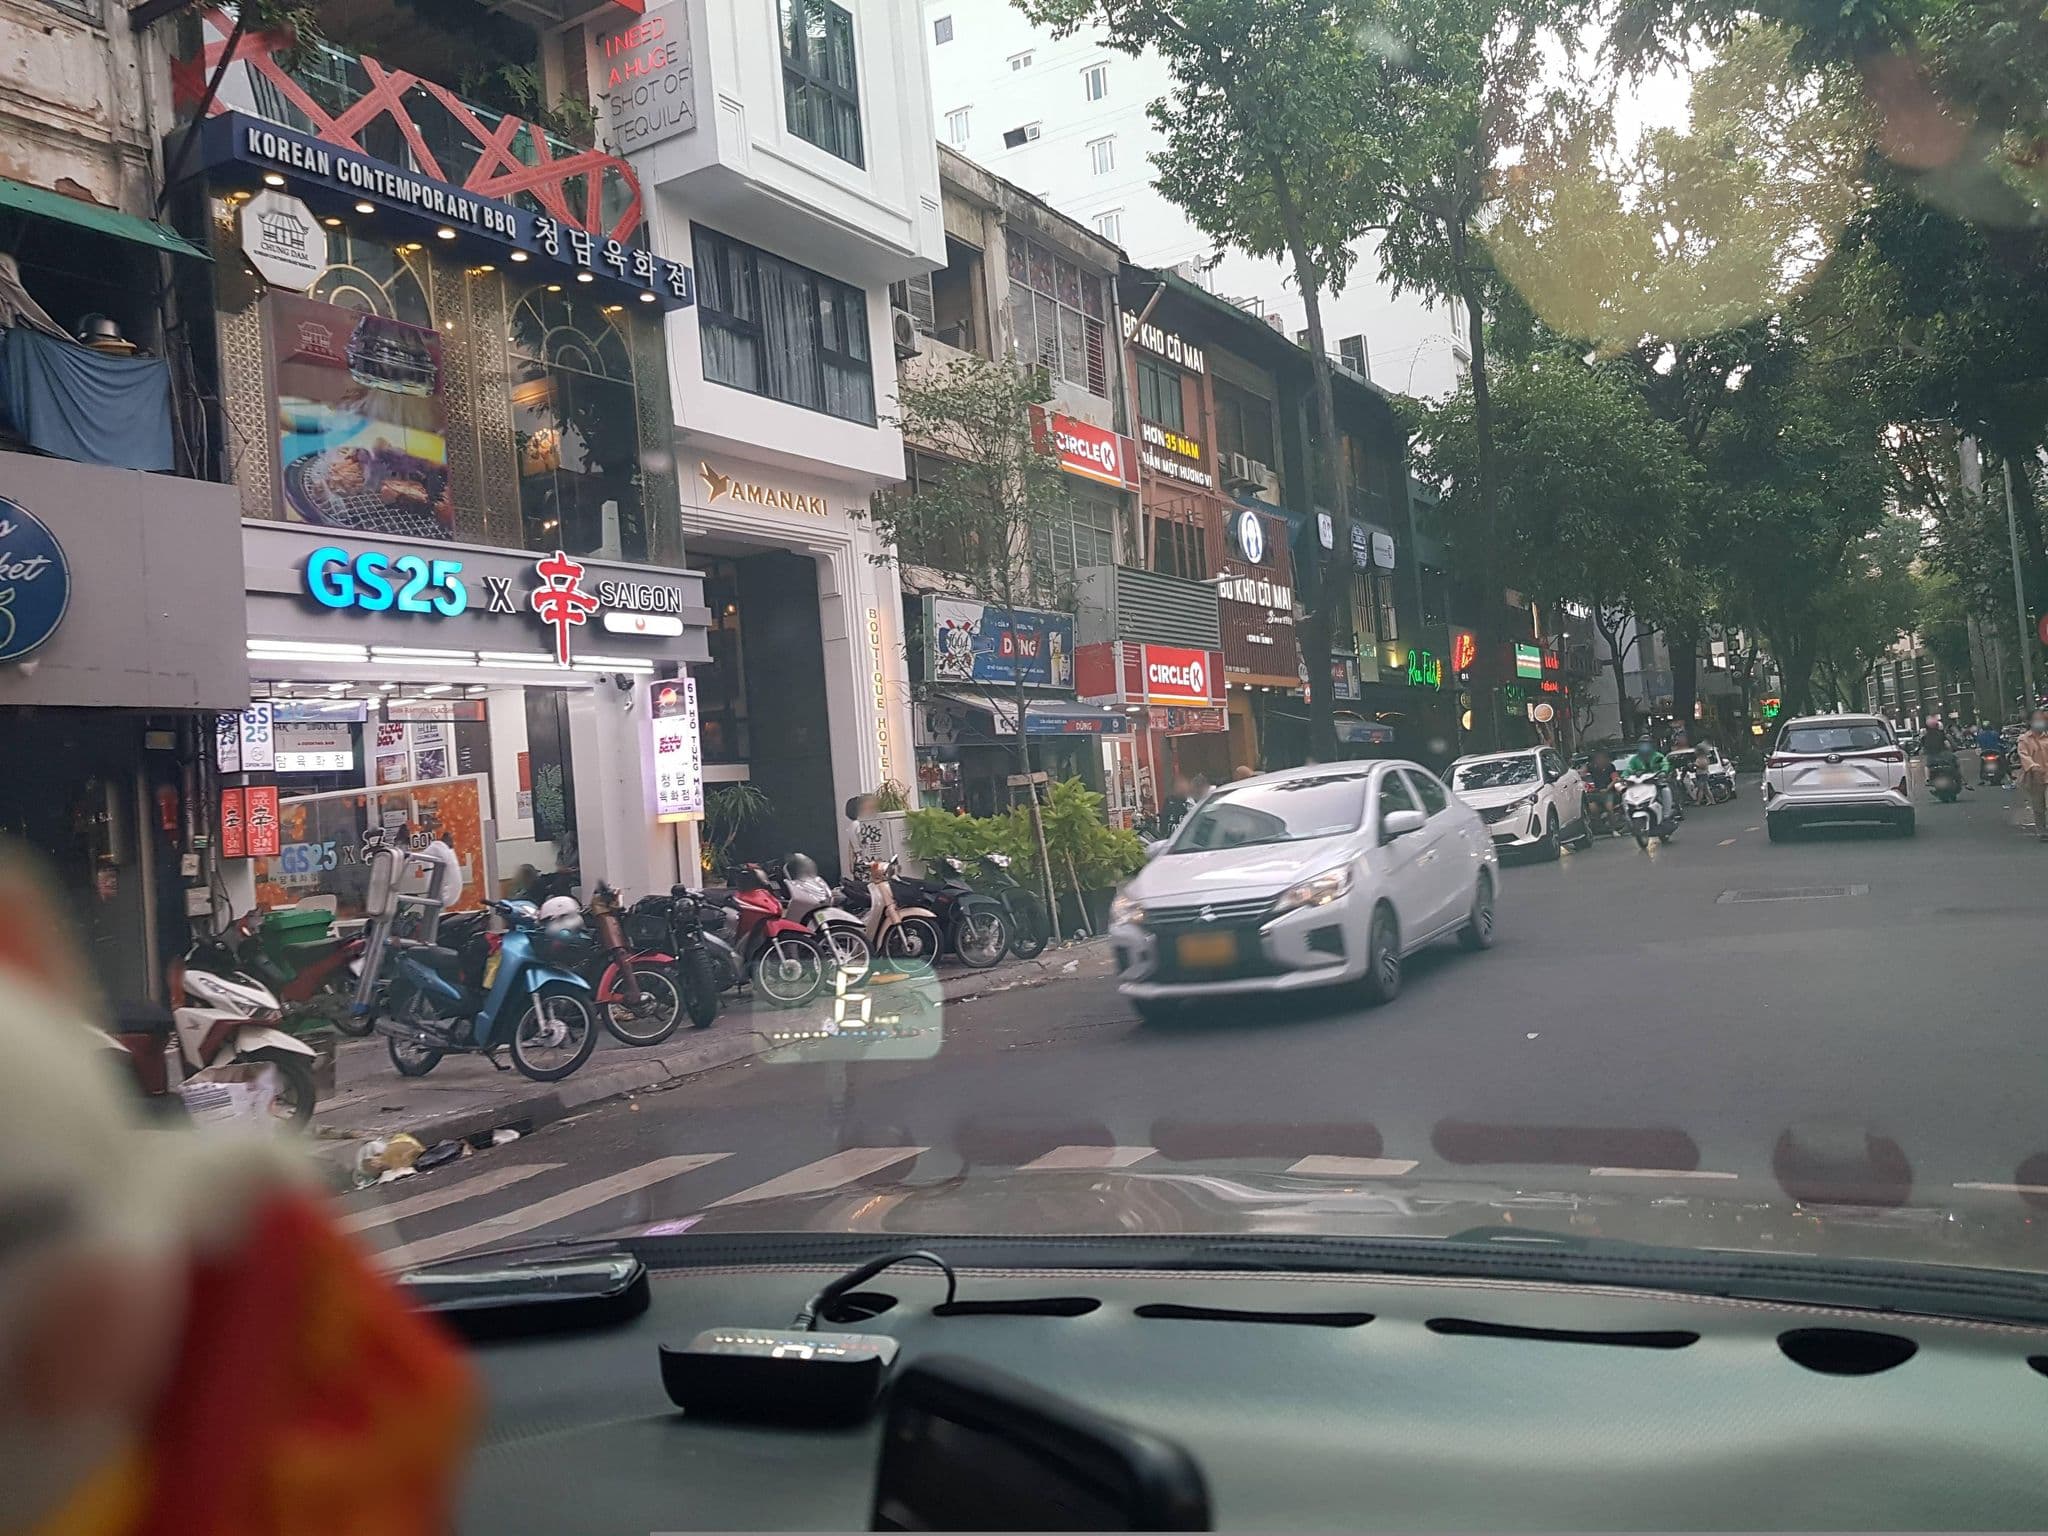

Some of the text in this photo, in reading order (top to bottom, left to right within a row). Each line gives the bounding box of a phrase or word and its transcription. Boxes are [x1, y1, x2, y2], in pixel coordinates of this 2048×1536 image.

[606, 16, 666, 59] I NEED
[608, 41, 678, 89] A HUGE
[610, 67, 690, 117] SHOT OF
[612, 100, 693, 148] TEQUILA
[248, 127, 330, 177] KOREAN
[337, 157, 479, 223] CONTEMPORARY
[484, 206, 517, 239] BBQ
[261, 242, 290, 257] CHUNG
[1141, 322, 1165, 355] KHO
[1166, 333, 1182, 363] CÔ
[1183, 342, 1205, 375] MAI
[1056, 431, 1101, 462] CIRCLE
[1165, 433, 1177, 451] 35
[730, 480, 829, 517] AMANAKI
[306, 546, 683, 669] GS25 X 辛 SAIGON
[1234, 577, 1257, 605] KHO
[1258, 576, 1272, 607] CÔ
[1272, 583, 1292, 611] MAI
[1003, 636, 1037, 657] DNG
[687, 683, 695, 705] 63
[1149, 663, 1190, 686] CIRCLE
[1191, 664, 1203, 690] K
[867, 608, 891, 784] BOUTIQUE HOTEL
[243, 707, 269, 725] GS
[244, 725, 269, 743] 25
[281, 841, 338, 874] GS25
